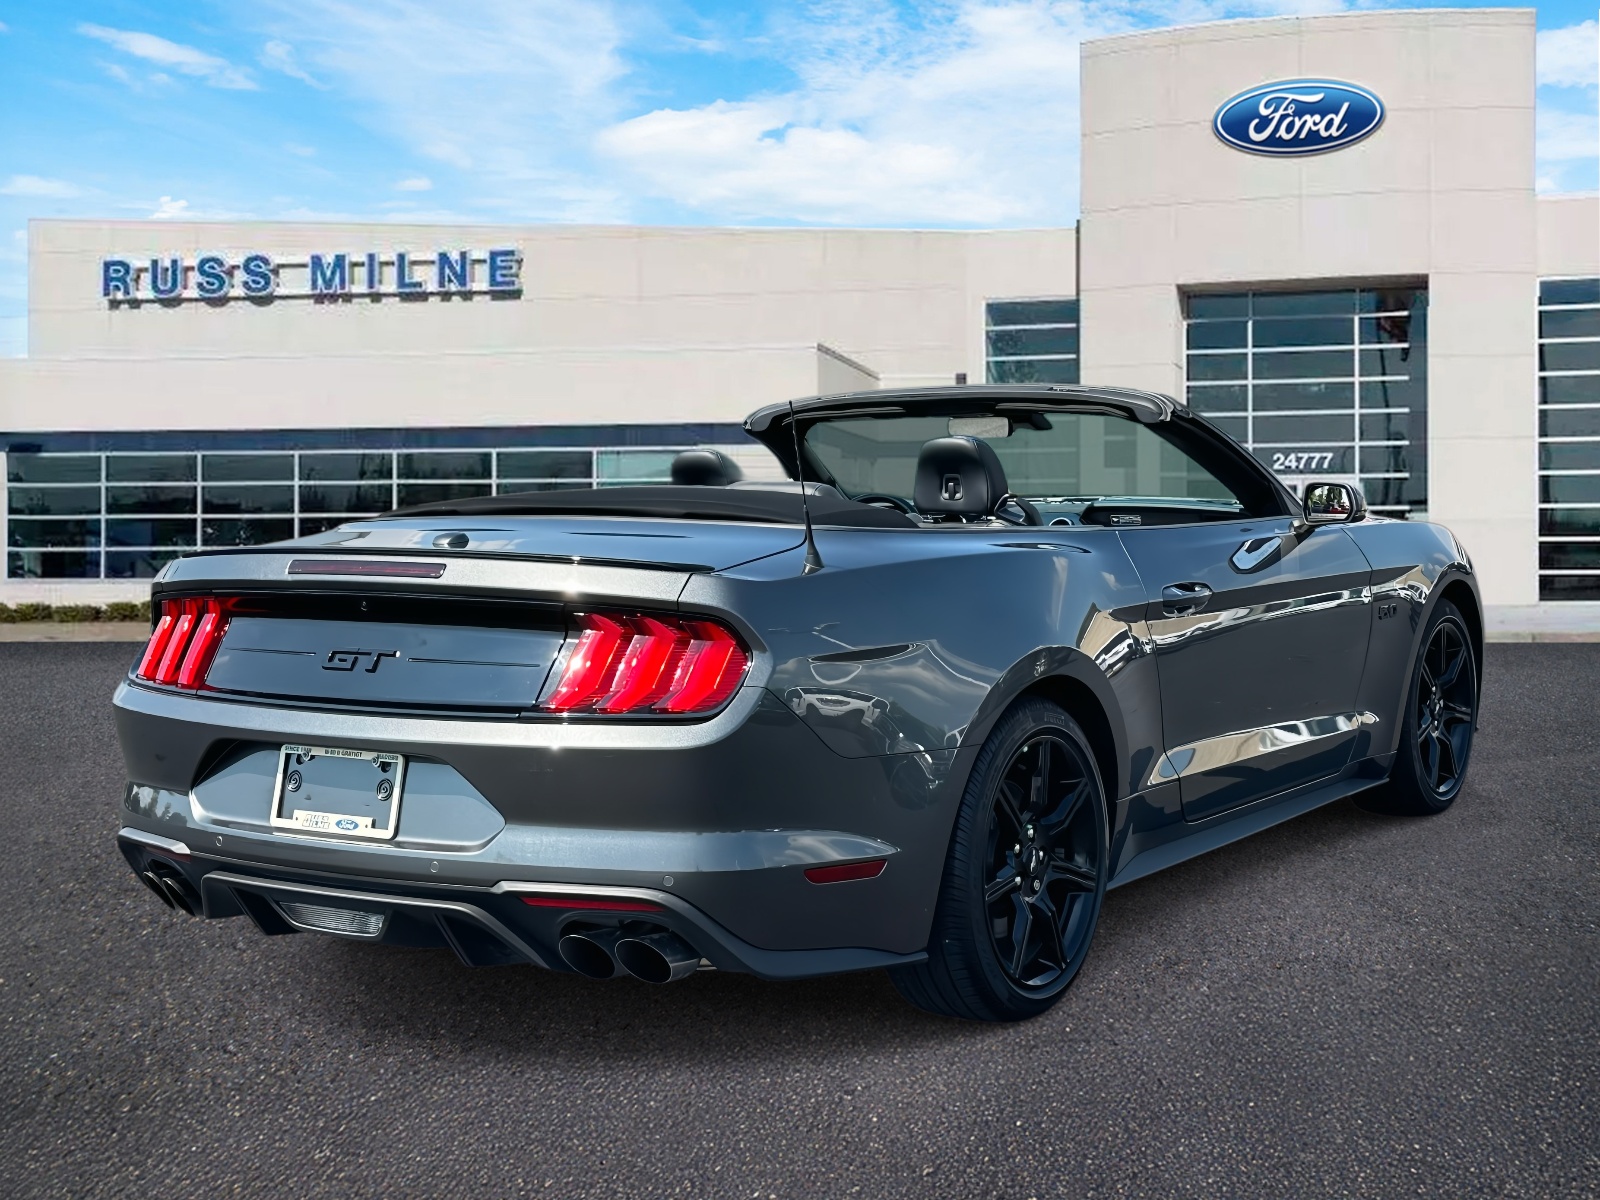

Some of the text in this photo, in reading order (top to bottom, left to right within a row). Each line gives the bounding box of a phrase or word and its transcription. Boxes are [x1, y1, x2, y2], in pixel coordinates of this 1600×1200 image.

[1248, 92, 1351, 143] Ford
[101, 246, 522, 299] RUSS MILNE
[1272, 452, 1334, 470] 24777
[321, 648, 401, 674] GT
